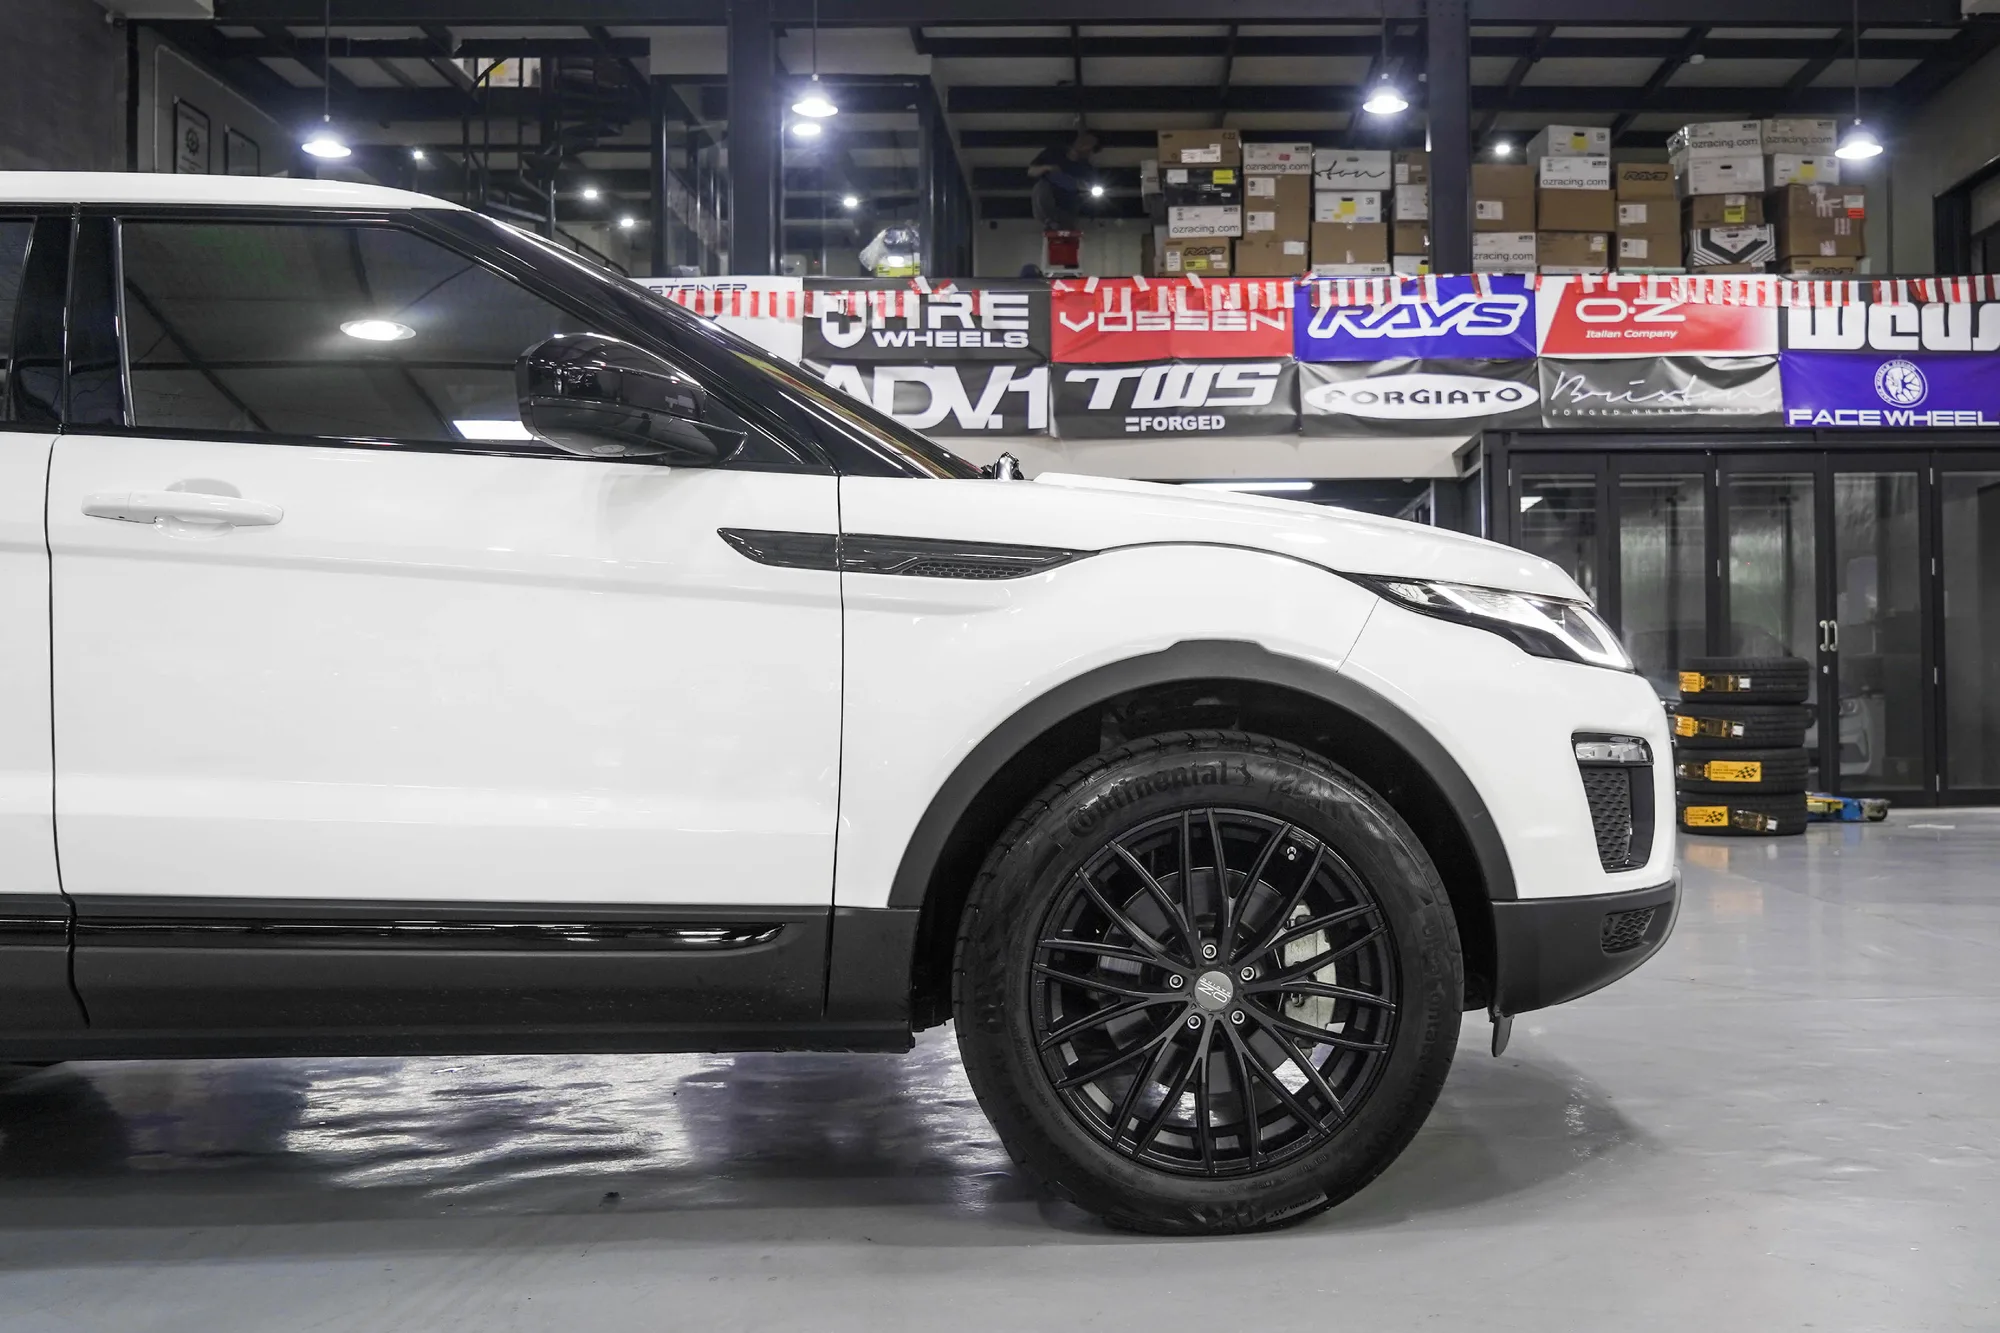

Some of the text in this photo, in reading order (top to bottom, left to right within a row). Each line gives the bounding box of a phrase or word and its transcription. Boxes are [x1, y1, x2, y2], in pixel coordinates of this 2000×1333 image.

[1692, 137, 1758, 149] ozracing.com
[1766, 135, 1832, 146] ozracing.com
[1245, 163, 1310, 173] ozracing.com
[1542, 177, 1608, 188] ozracing.com
[1171, 224, 1239, 235] ozracing.com
[1473, 251, 1534, 262] zracing.com
[648, 284, 748, 294] STEINER
[1059, 311, 1285, 332] VOSSEN
[1308, 294, 1528, 338] RAYS
[872, 331, 1029, 348] WHEELS
[1585, 329, 1679, 340] Italian Company
[1065, 363, 1282, 410] TWS
[1324, 387, 1523, 405] FORGIATO
[1789, 409, 1999, 426] FACE WHEEL
[1065, 760, 1228, 837] Continental
